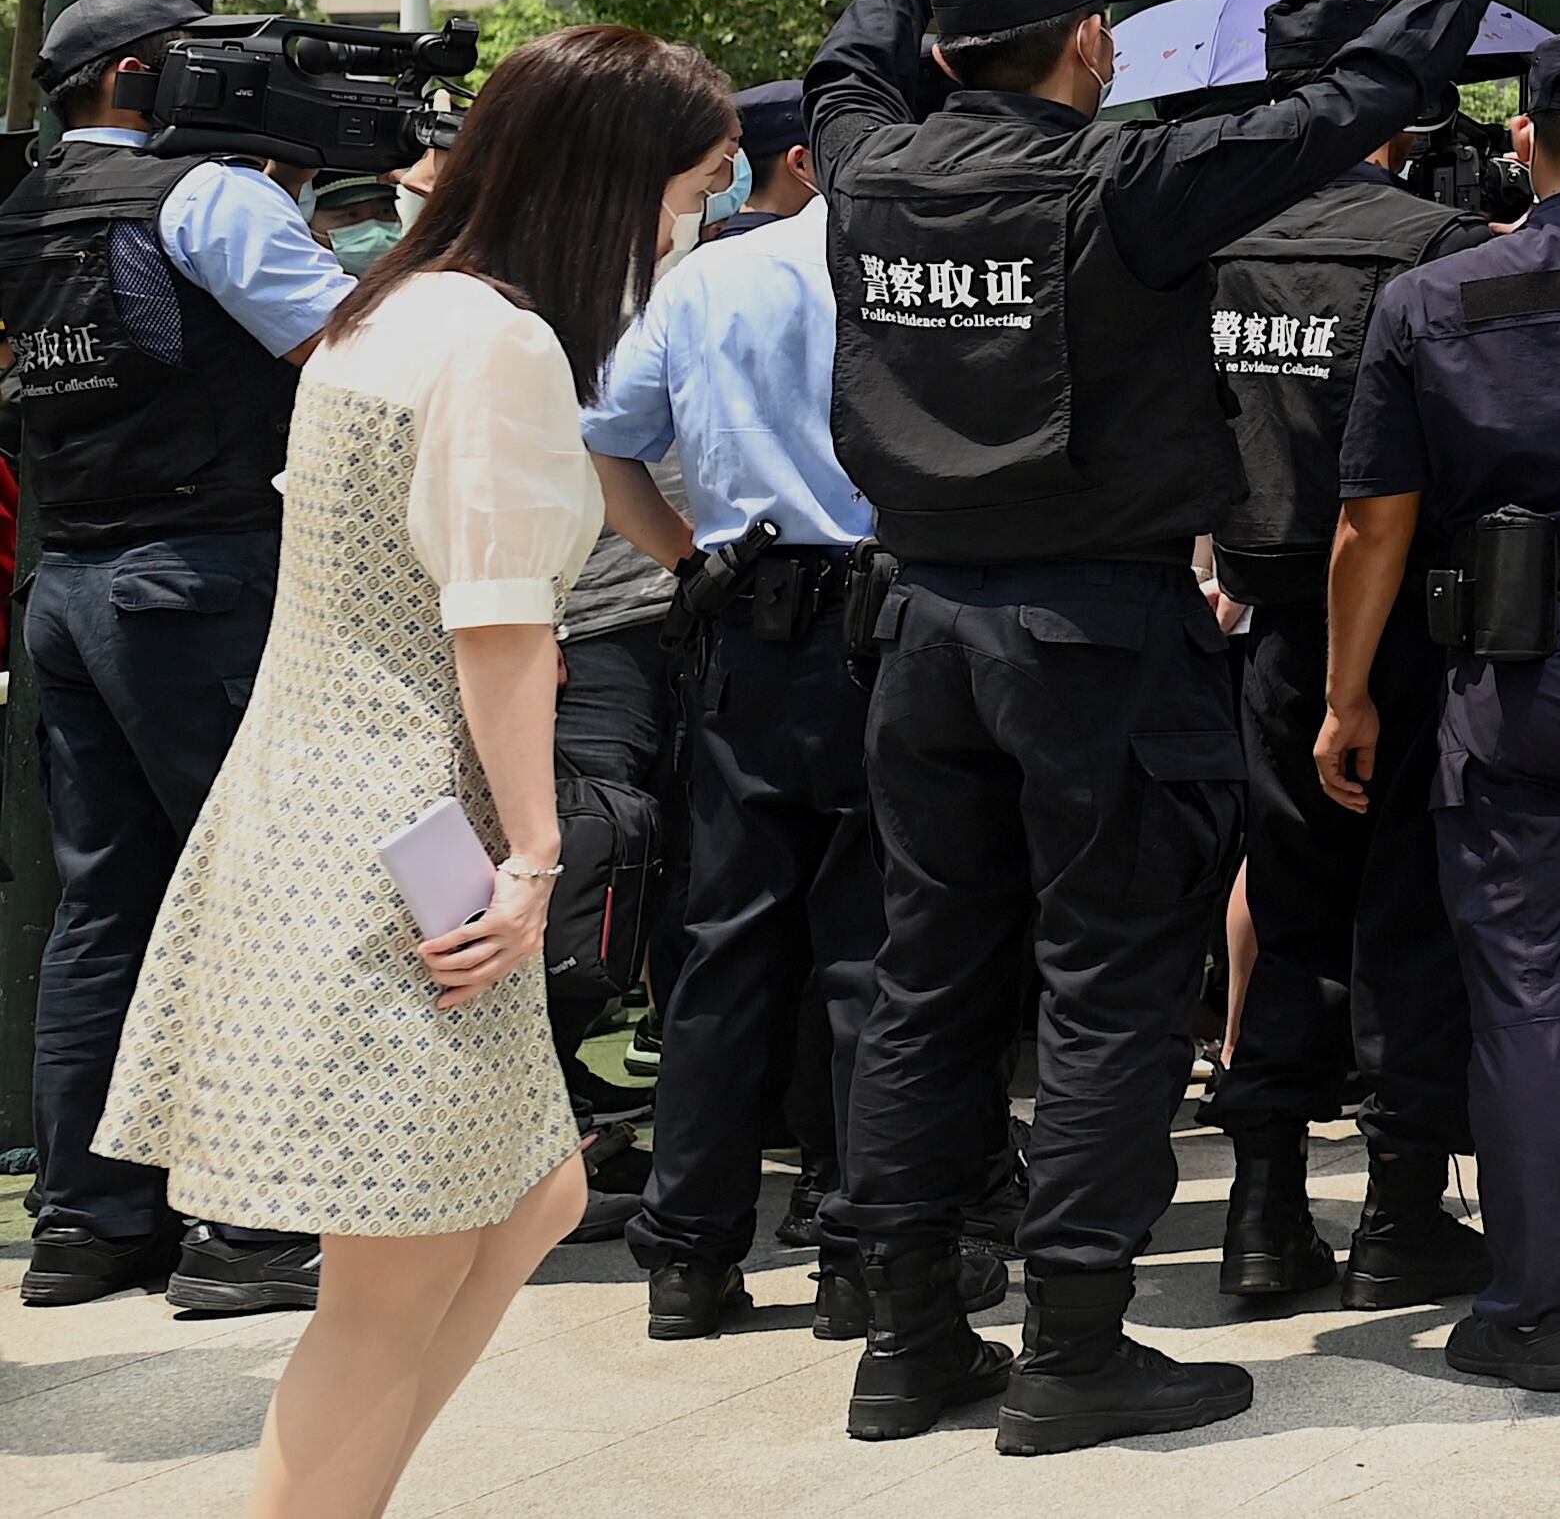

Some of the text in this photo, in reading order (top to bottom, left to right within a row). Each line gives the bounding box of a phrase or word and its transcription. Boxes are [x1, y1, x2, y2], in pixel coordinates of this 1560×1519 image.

[235, 89, 253, 97] JVC
[859, 253, 1034, 309] 警察取证
[860, 307, 896, 323] Police
[949, 313, 1032, 329] Collecting
[1210, 310, 1340, 357] 警察取证
[54, 375, 119, 394] Collecting
